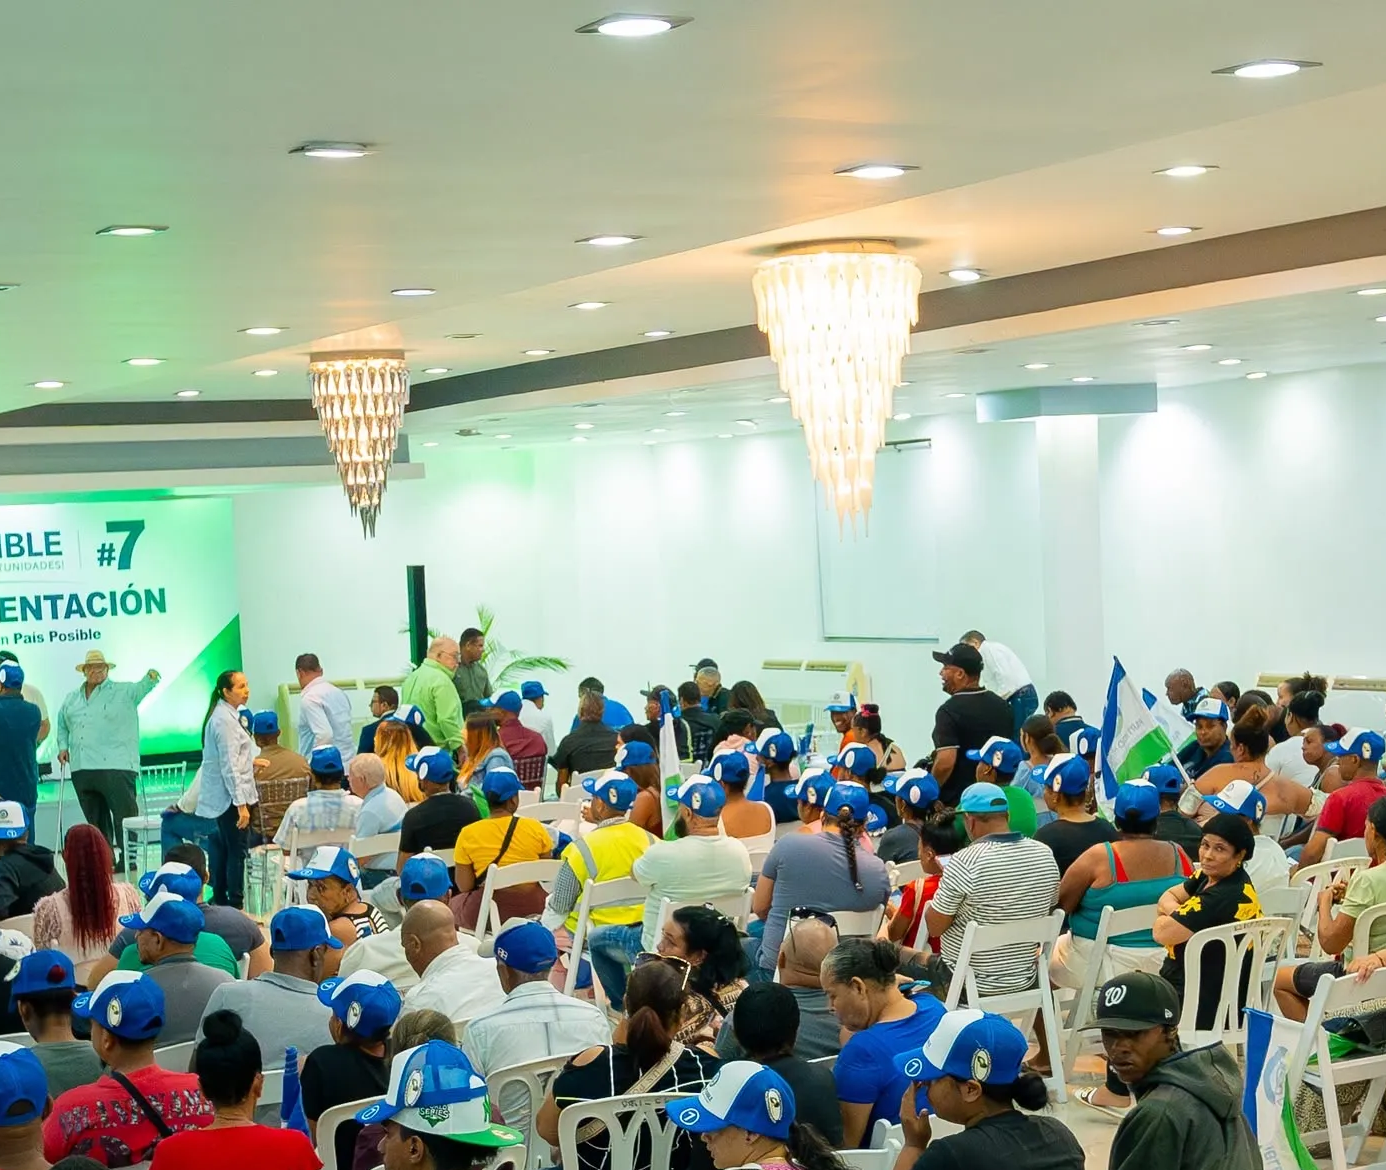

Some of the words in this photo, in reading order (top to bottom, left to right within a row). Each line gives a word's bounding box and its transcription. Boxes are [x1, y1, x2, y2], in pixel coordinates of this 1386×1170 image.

[97, 519, 145, 571] #7
[49, 628, 102, 642] Posible
[419, 1107, 450, 1119] SERIES
